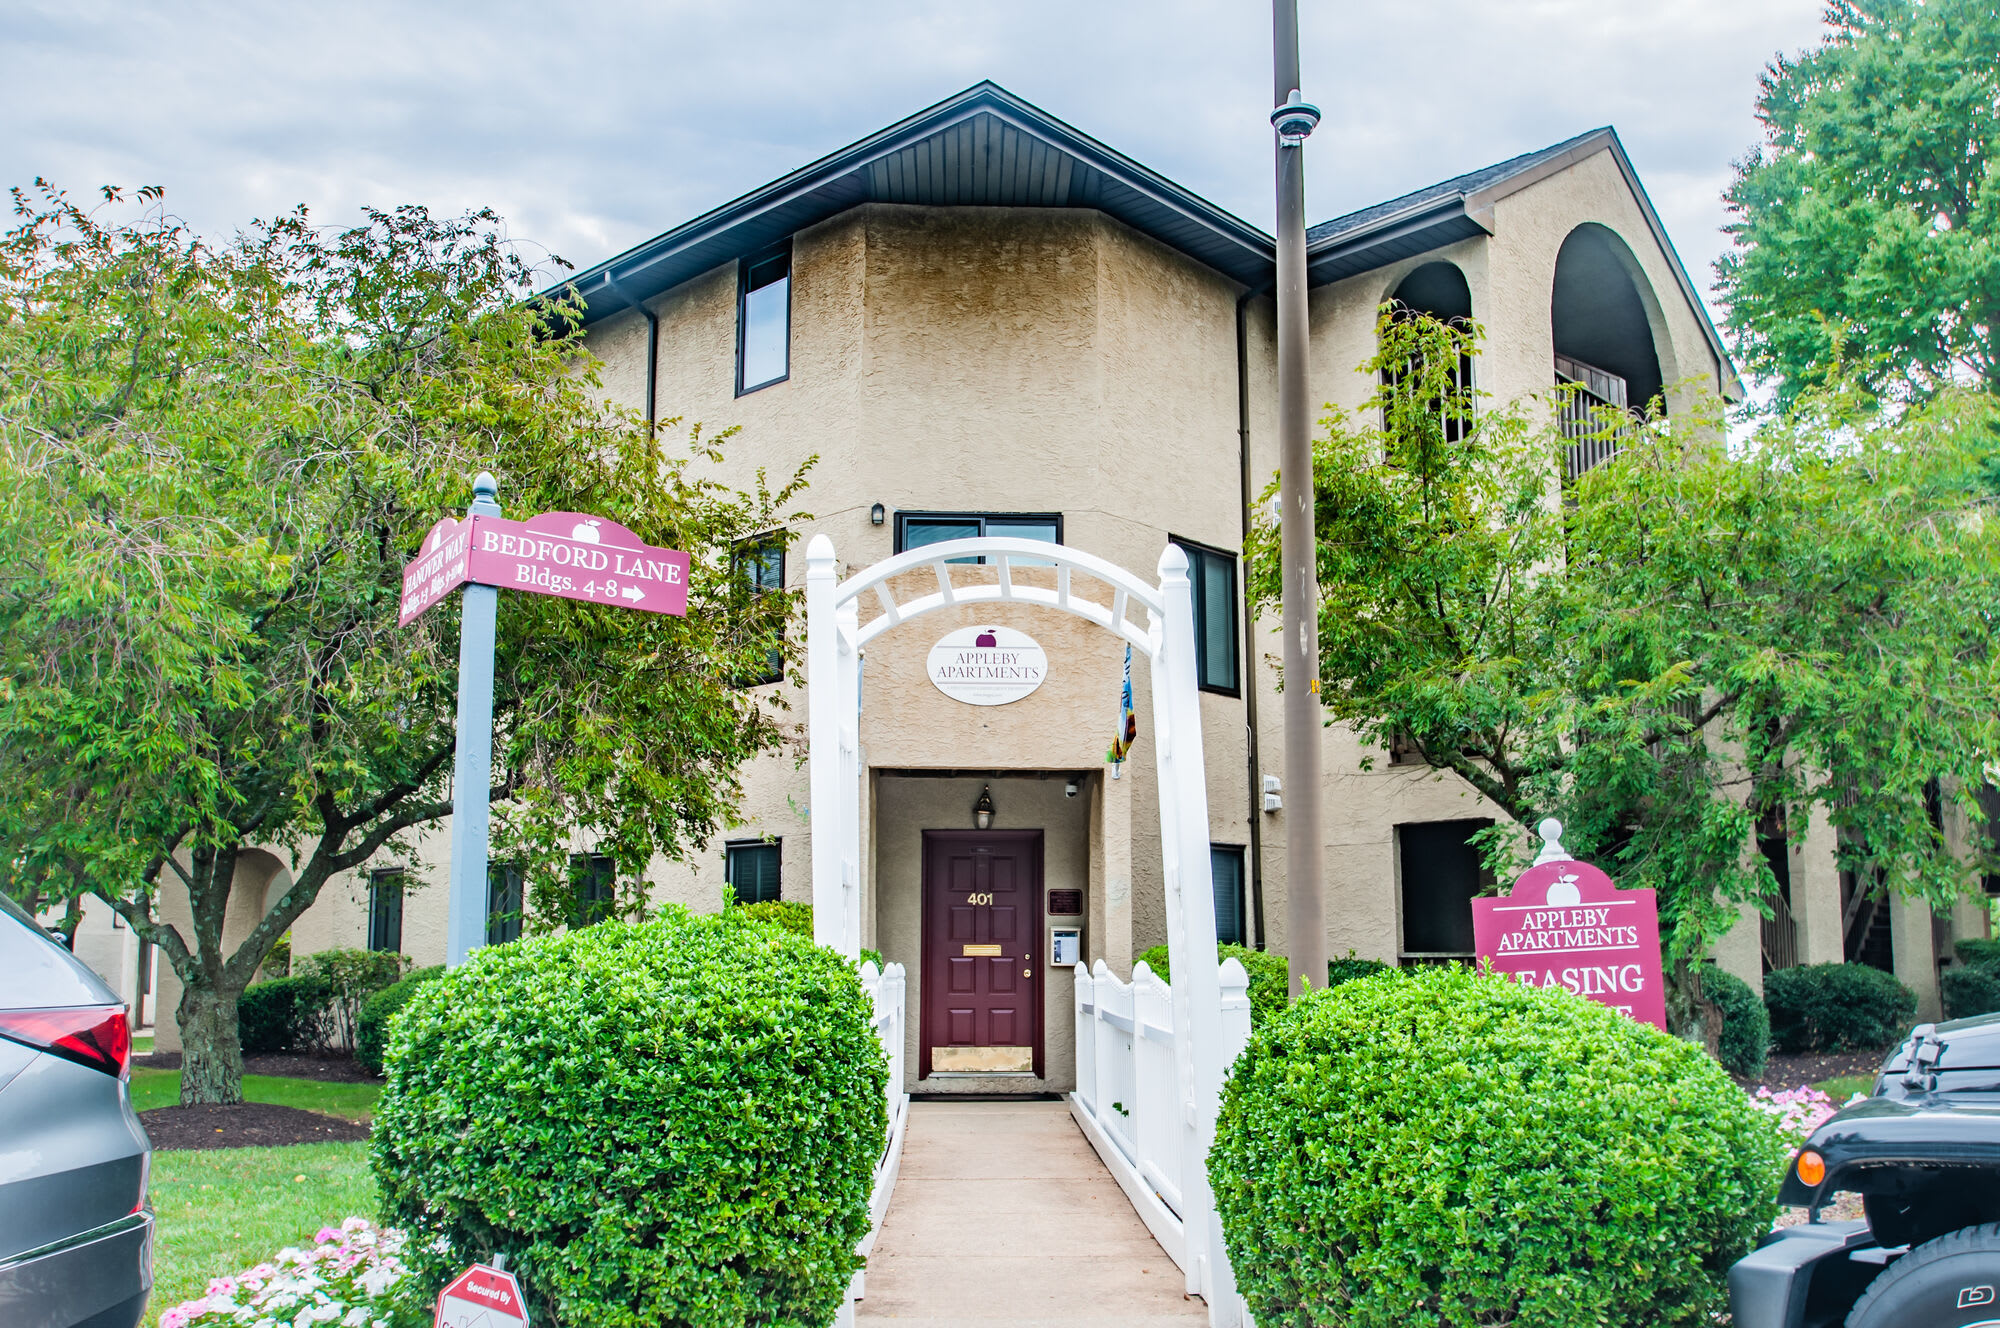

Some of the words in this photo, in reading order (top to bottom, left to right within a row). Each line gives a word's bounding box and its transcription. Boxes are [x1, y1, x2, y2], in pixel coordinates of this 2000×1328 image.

[405, 551, 444, 596] HANOVER
[445, 532, 465, 563] WAY
[482, 531, 608, 571] BEDFORD
[614, 554, 681, 584] LANE
[515, 564, 577, 593] Bldgs.
[583, 578, 617, 598] 4-8
[956, 653, 1019, 665] APPLEBY
[937, 666, 1039, 679] APARTMENTS
[967, 893, 993, 906] 401
[1522, 908, 1610, 930] APPLEBY
[1498, 926, 1638, 951] APARTMENTS
[1515, 964, 1645, 996] EASING
[466, 1281, 500, 1300] Secured
[500, 1290, 512, 1306] By
